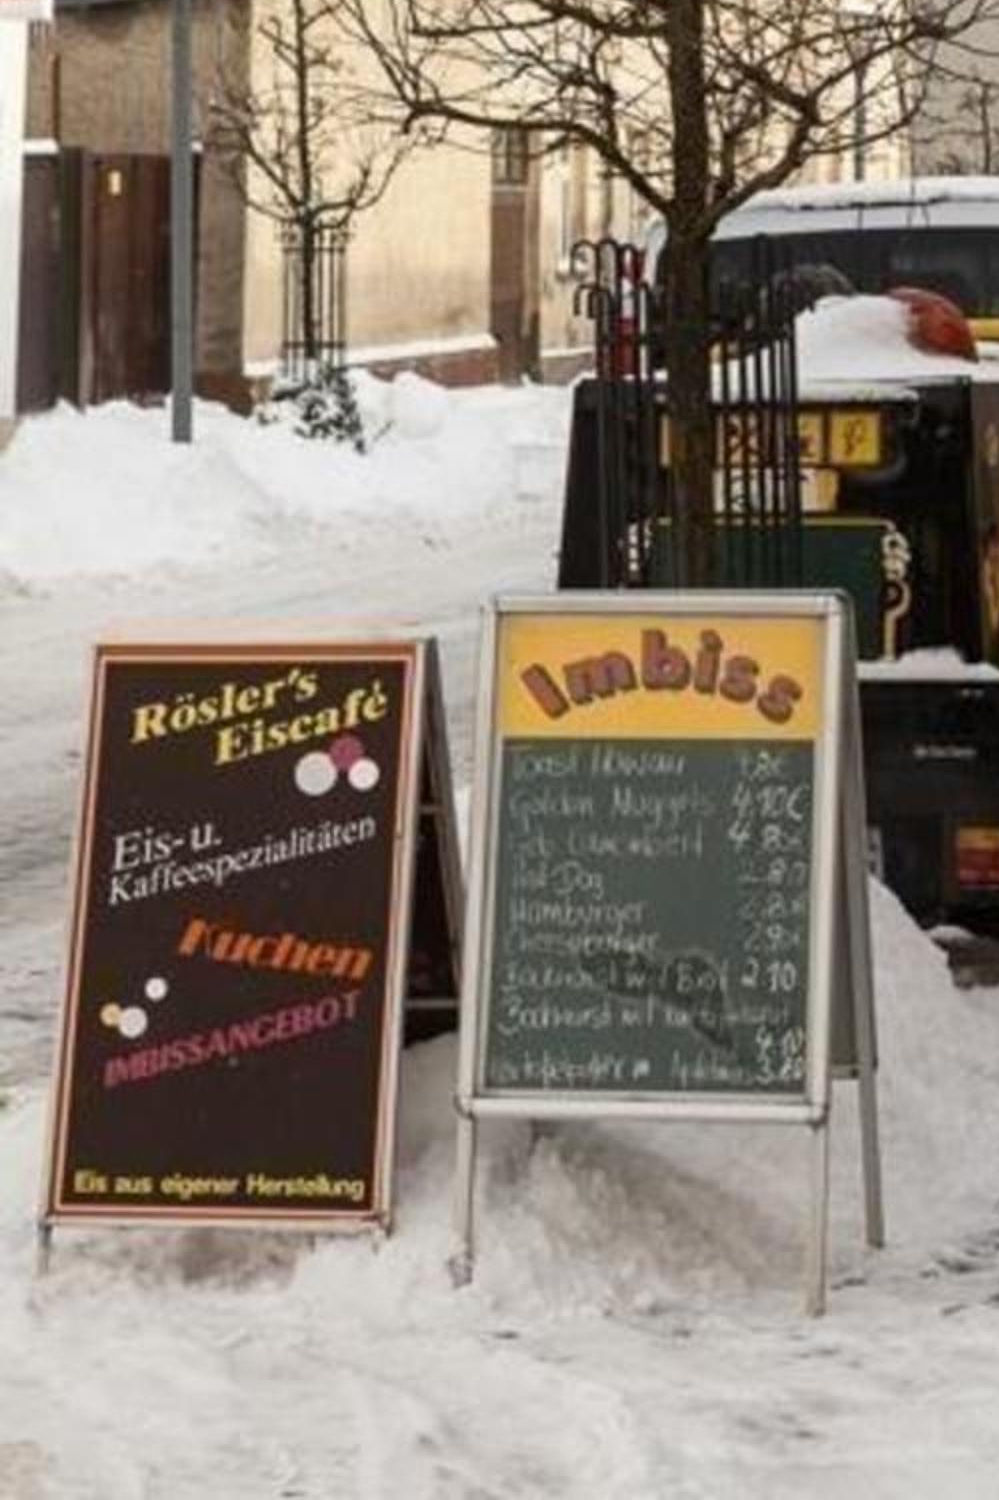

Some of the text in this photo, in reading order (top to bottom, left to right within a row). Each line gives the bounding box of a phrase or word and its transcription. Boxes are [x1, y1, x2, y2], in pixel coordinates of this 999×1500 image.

[129, 668, 319, 745] Rösler's
[521, 628, 802, 726] Imbiss
[214, 678, 389, 766] Eiscafé
[108, 814, 377, 906] Kaffeespezialitäten
[112, 822, 223, 873] Eis- u.
[178, 917, 373, 979] Kuchen
[103, 988, 362, 1089] IMBISSANGEBOT
[74, 1171, 366, 1201] Eis aus eigener Herstellung
